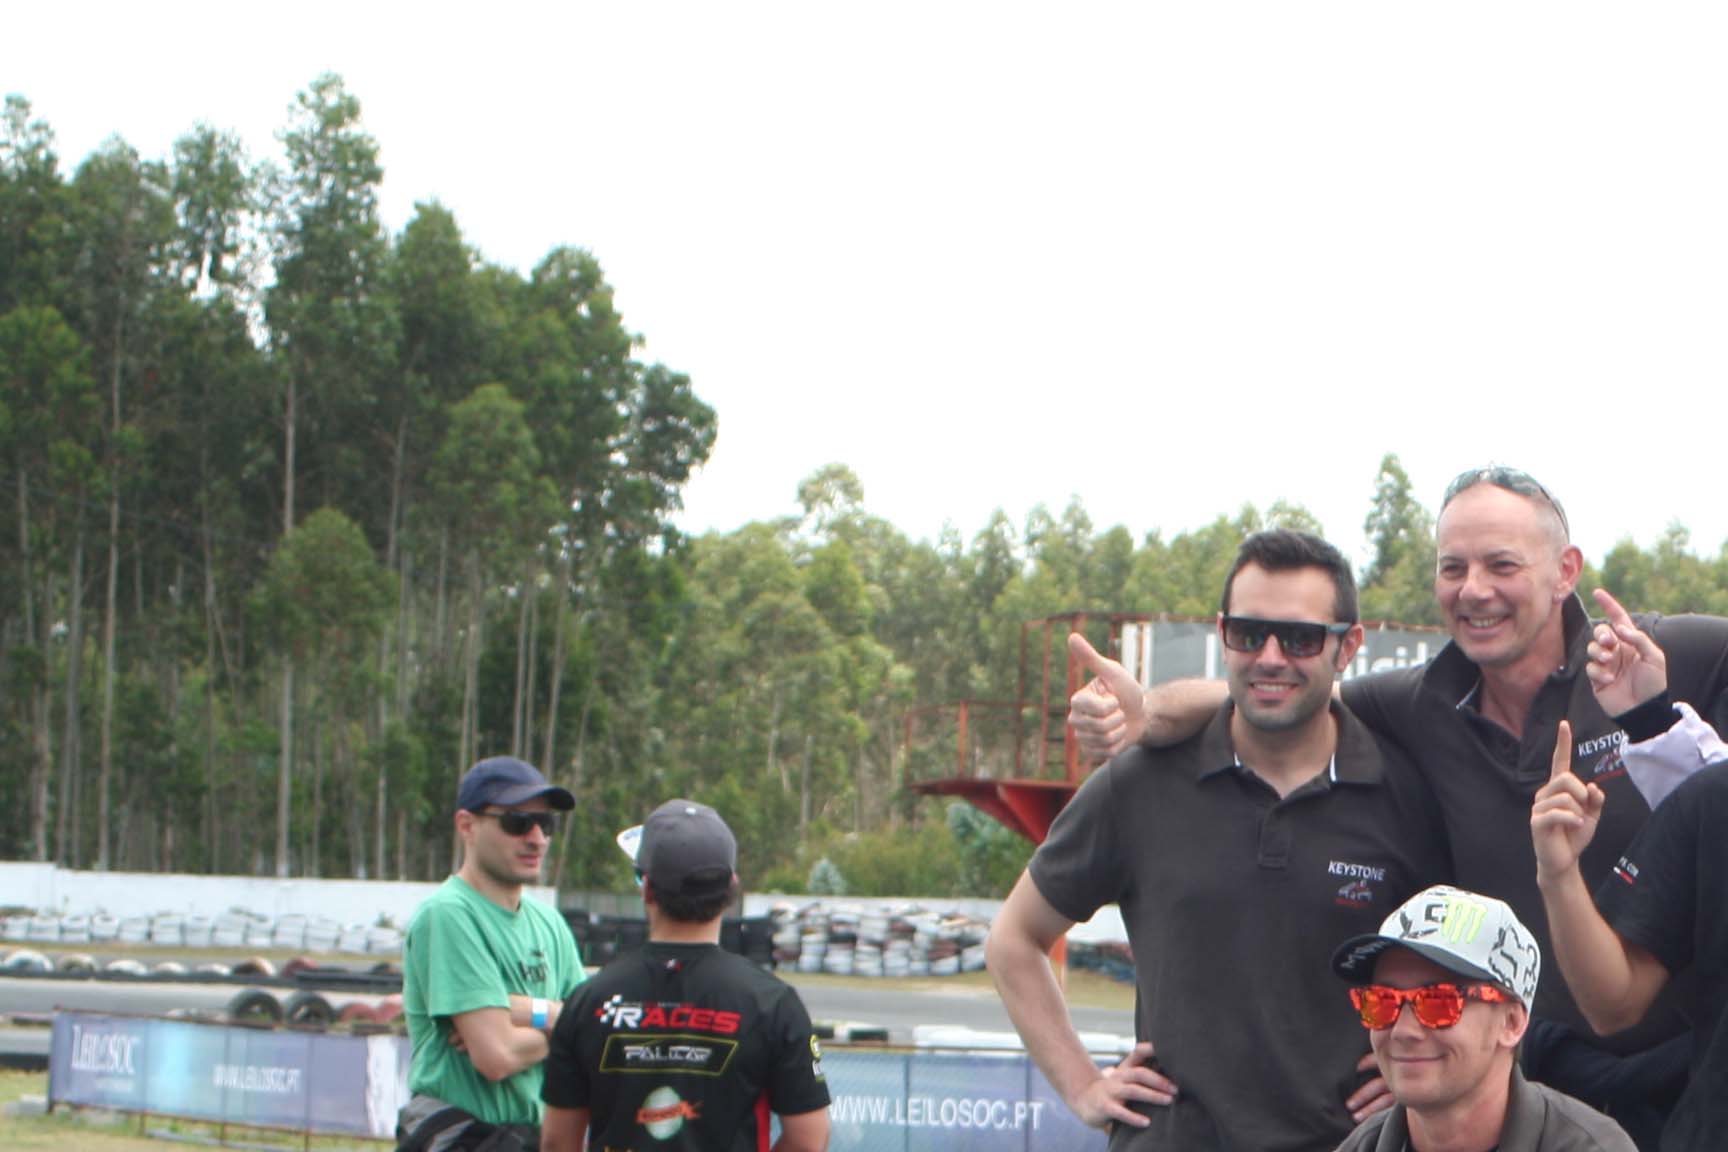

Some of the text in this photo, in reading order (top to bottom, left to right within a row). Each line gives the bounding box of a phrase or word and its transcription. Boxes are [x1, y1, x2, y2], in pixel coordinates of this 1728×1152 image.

[1578, 729, 1627, 757] KEYSTO
[1328, 861, 1386, 880] KEYSTONE
[612, 1006, 742, 1034] RACES
[828, 1095, 1043, 1130] WWW.LEILOSOC.PT
